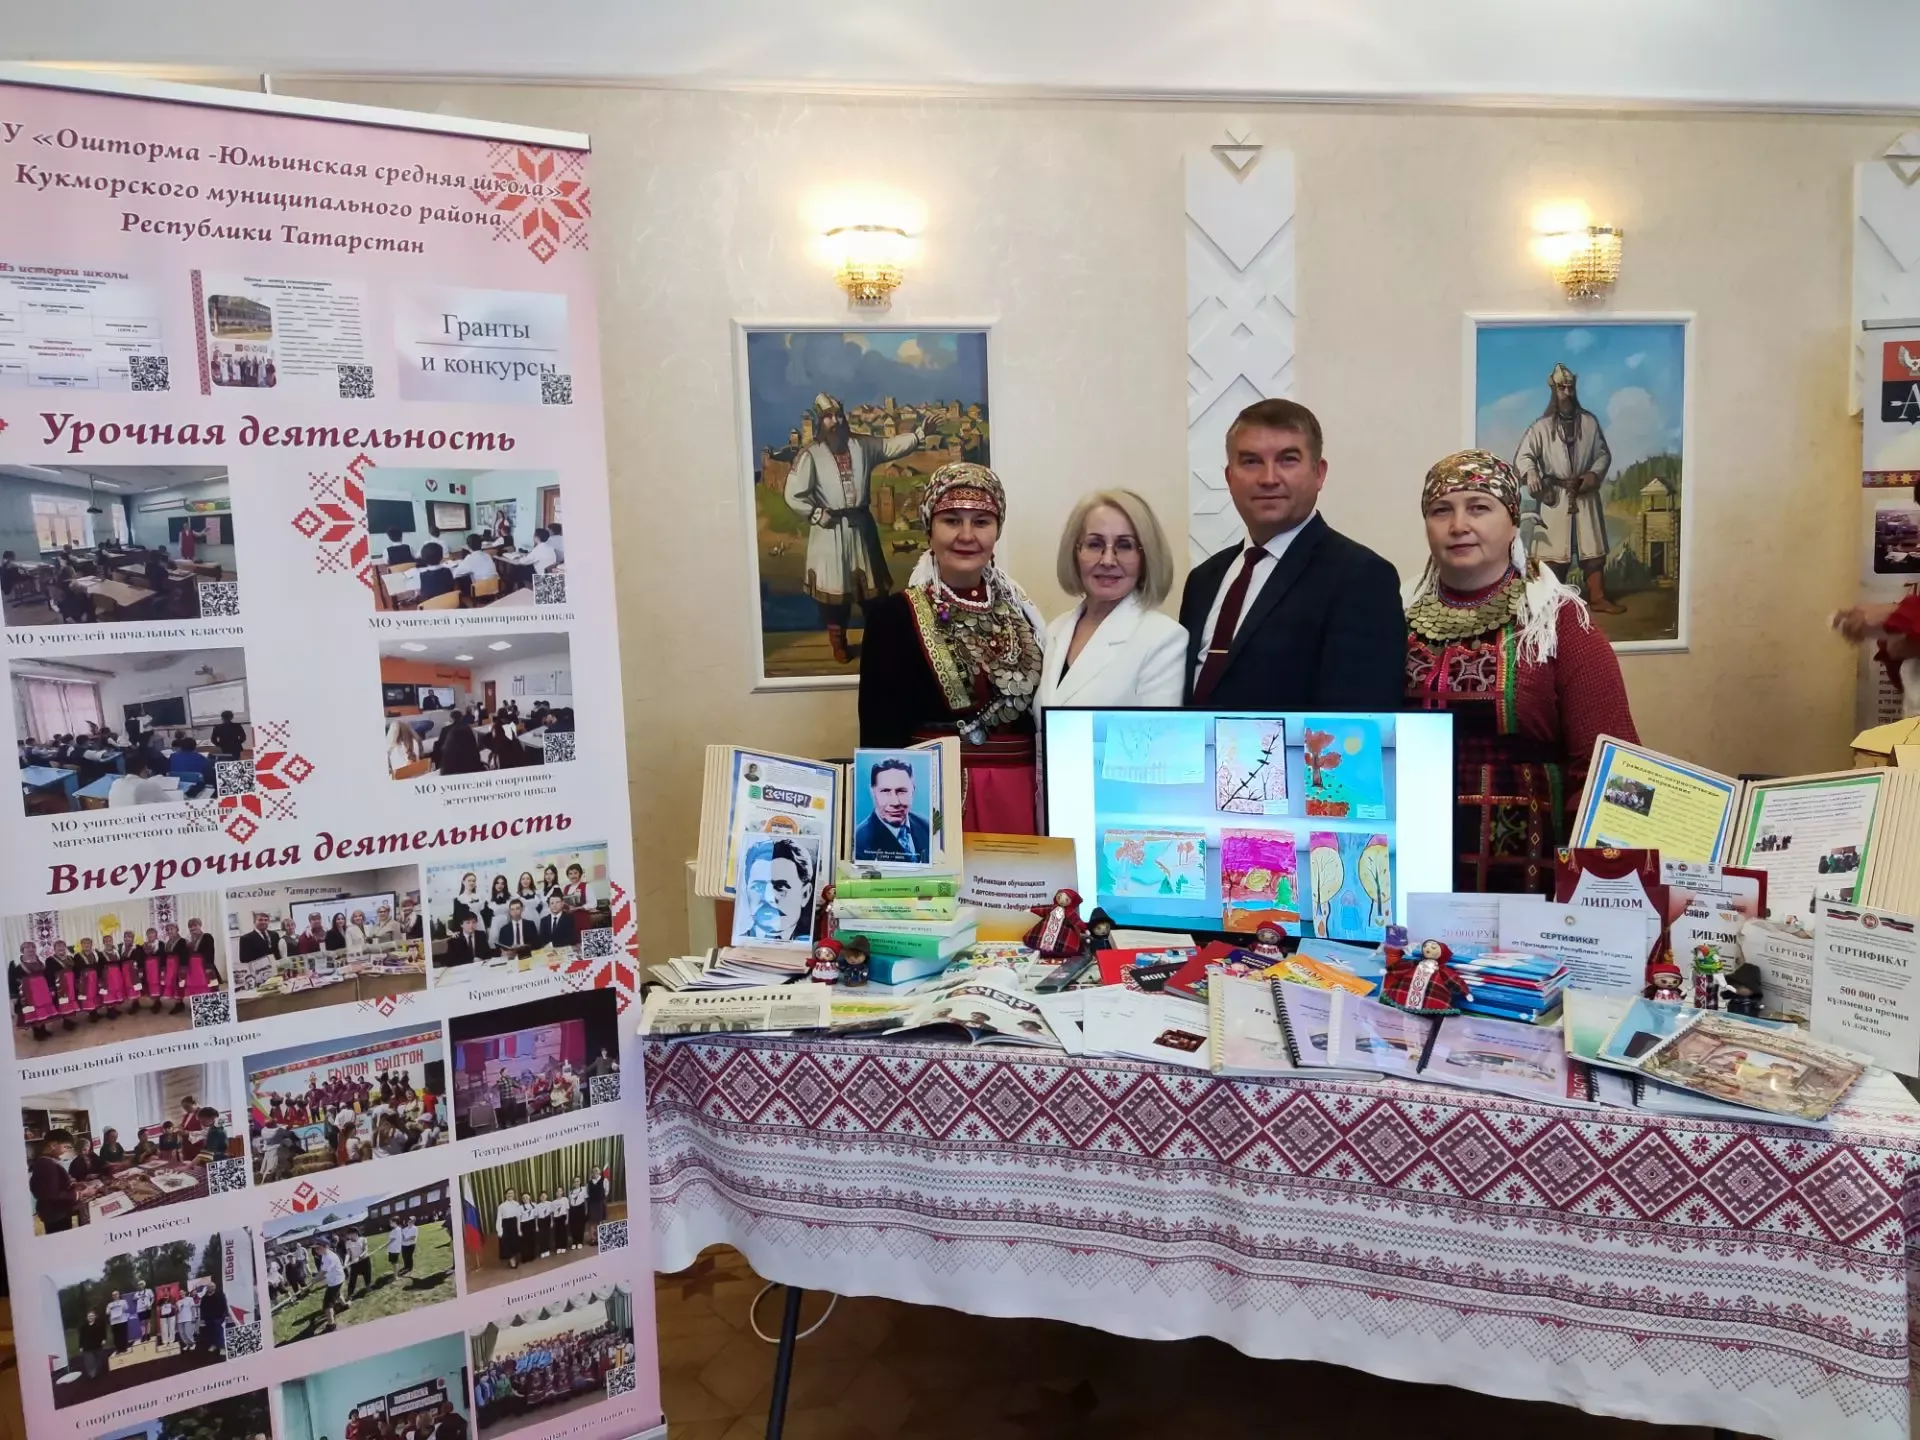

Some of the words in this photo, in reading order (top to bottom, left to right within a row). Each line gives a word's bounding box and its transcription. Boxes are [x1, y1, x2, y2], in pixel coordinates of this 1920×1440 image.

[32, 127, 200, 163] «Ошторма
[208, 144, 368, 179] -Юмьинская
[375, 164, 466, 189] средняя
[472, 174, 562, 198] школа»
[15, 163, 199, 199] Кукморского
[206, 185, 412, 220] муниципального
[419, 204, 502, 226] района
[121, 212, 272, 244] Республики
[282, 223, 425, 255] Татарстан
[19, 265, 79, 277] истории
[83, 268, 129, 280] школы
[442, 313, 530, 342] Гранты
[420, 357, 436, 373] и
[442, 357, 556, 381] конкурсы
[40, 412, 227, 454] Урочная
[240, 415, 515, 453] деятельность
[368, 617, 391, 629] МО
[396, 615, 451, 630] учителей
[455, 613, 538, 629] гуманитарного
[541, 611, 575, 623] цикла
[5, 633, 34, 645] МО
[39, 630, 105, 646] учителей
[110, 626, 185, 640] начальных
[191, 625, 244, 636] классов
[414, 783, 437, 796] МО
[440, 777, 492, 796] учителей
[524, 785, 557, 798] цикла
[51, 820, 78, 834] МО
[83, 814, 146, 831] учителей
[52, 828, 173, 850] математического
[177, 823, 219, 837] цикла
[47, 841, 302, 895] Внеурочная
[313, 811, 572, 862] деятельность
[284, 886, 342, 896] Татарстана
[973, 876, 1006, 887] Публикации
[1008, 879, 1045, 889] обучающихся
[1520, 941, 1558, 951] Президента
[1540, 931, 1600, 946] СЕРТИФИКАТ
[1688, 928, 1737, 944] ДИПЛОМ
[1829, 944, 1909, 968] СЕРТИФИКАТ
[469, 978, 550, 1001] Краеведческий
[1839, 985, 1857, 997] 500
[1858, 989, 1876, 1001] 000
[17, 1052, 124, 1081] Танцевальный
[128, 1042, 199, 1061] коллектив
[471, 1136, 542, 1159] Театральные
[104, 1231, 132, 1245] Дом
